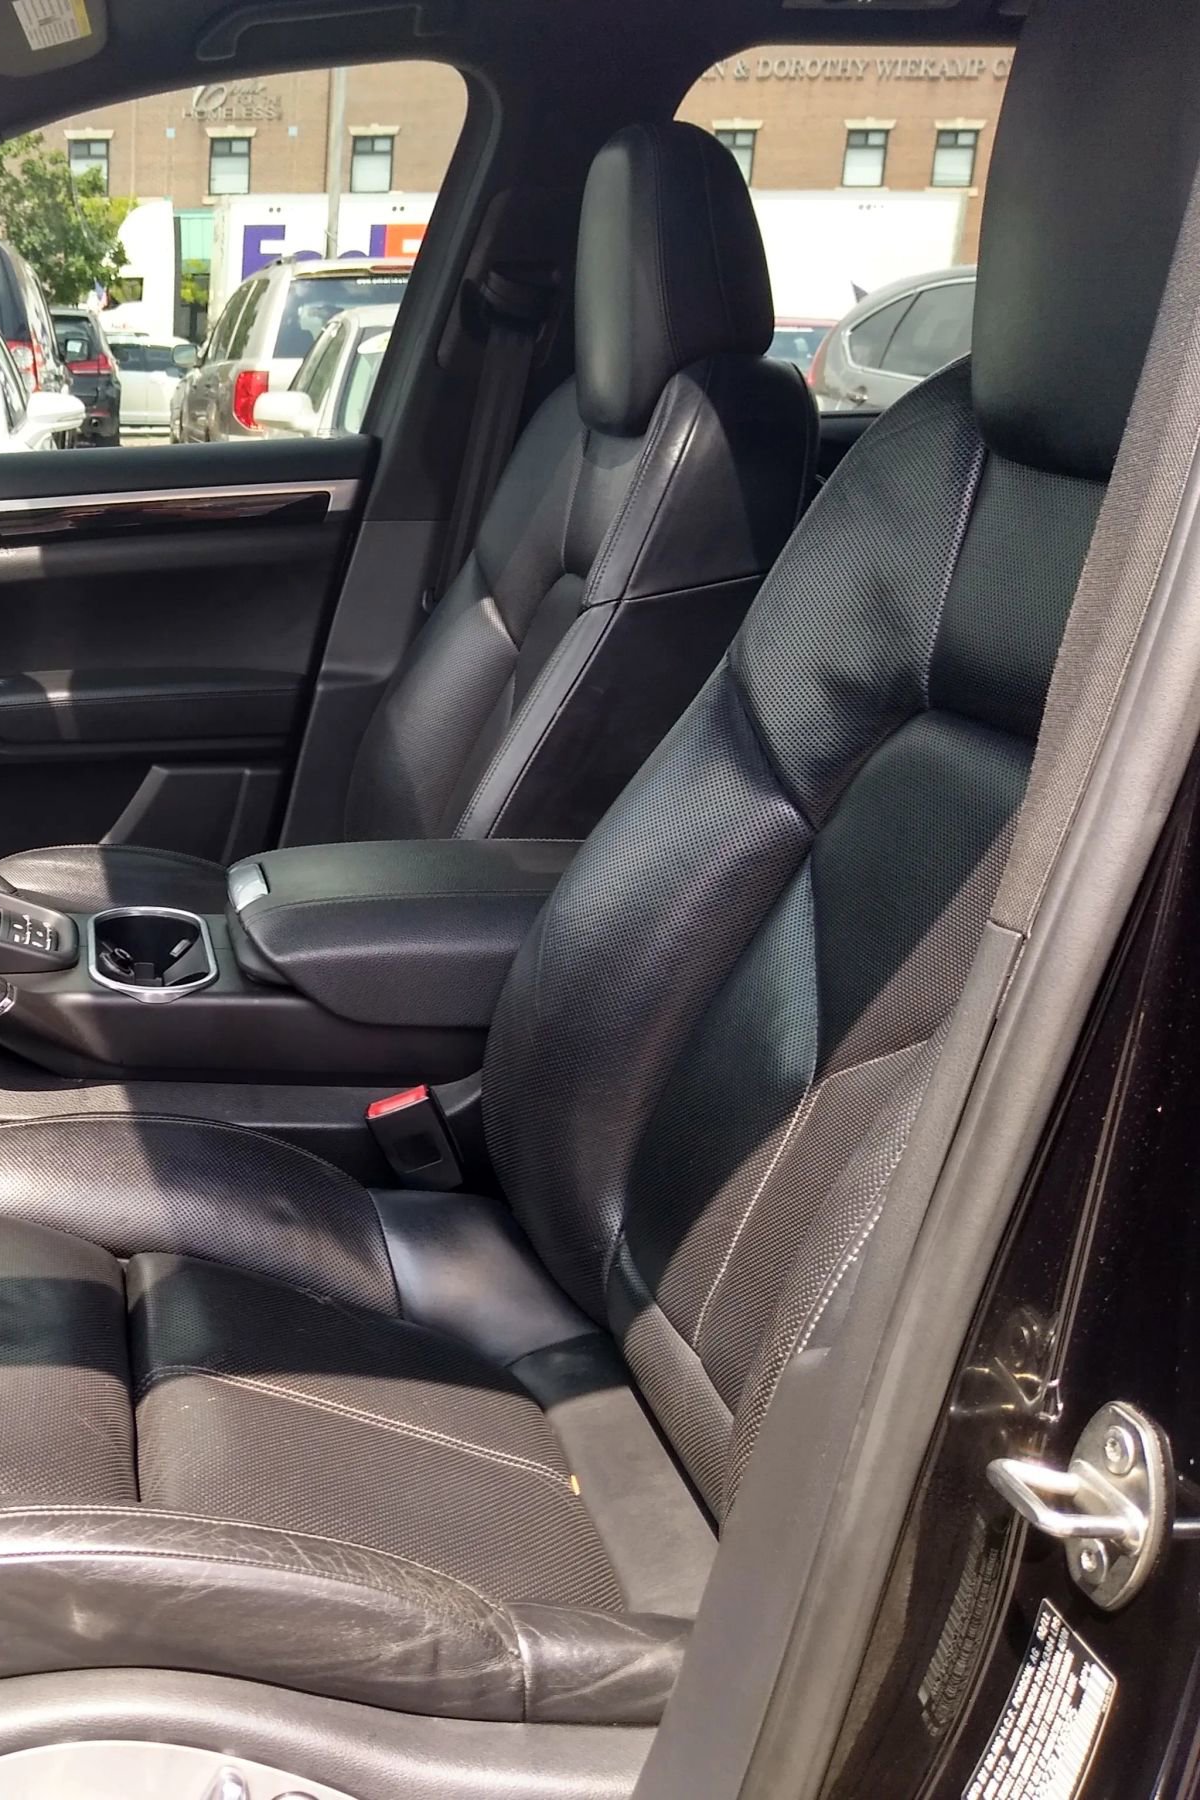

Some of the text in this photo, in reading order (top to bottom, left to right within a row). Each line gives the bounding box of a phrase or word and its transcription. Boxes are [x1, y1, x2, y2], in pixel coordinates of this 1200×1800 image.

[734, 59, 750, 79] &
[756, 57, 869, 80] DOROTHY
[875, 57, 986, 80] WIEKAMP
[992, 58, 1013, 80] C
[182, 107, 280, 121] HOMELESS
[1011, 1663, 1037, 1709] PORSCHE
[1029, 1647, 1041, 1665] AG
